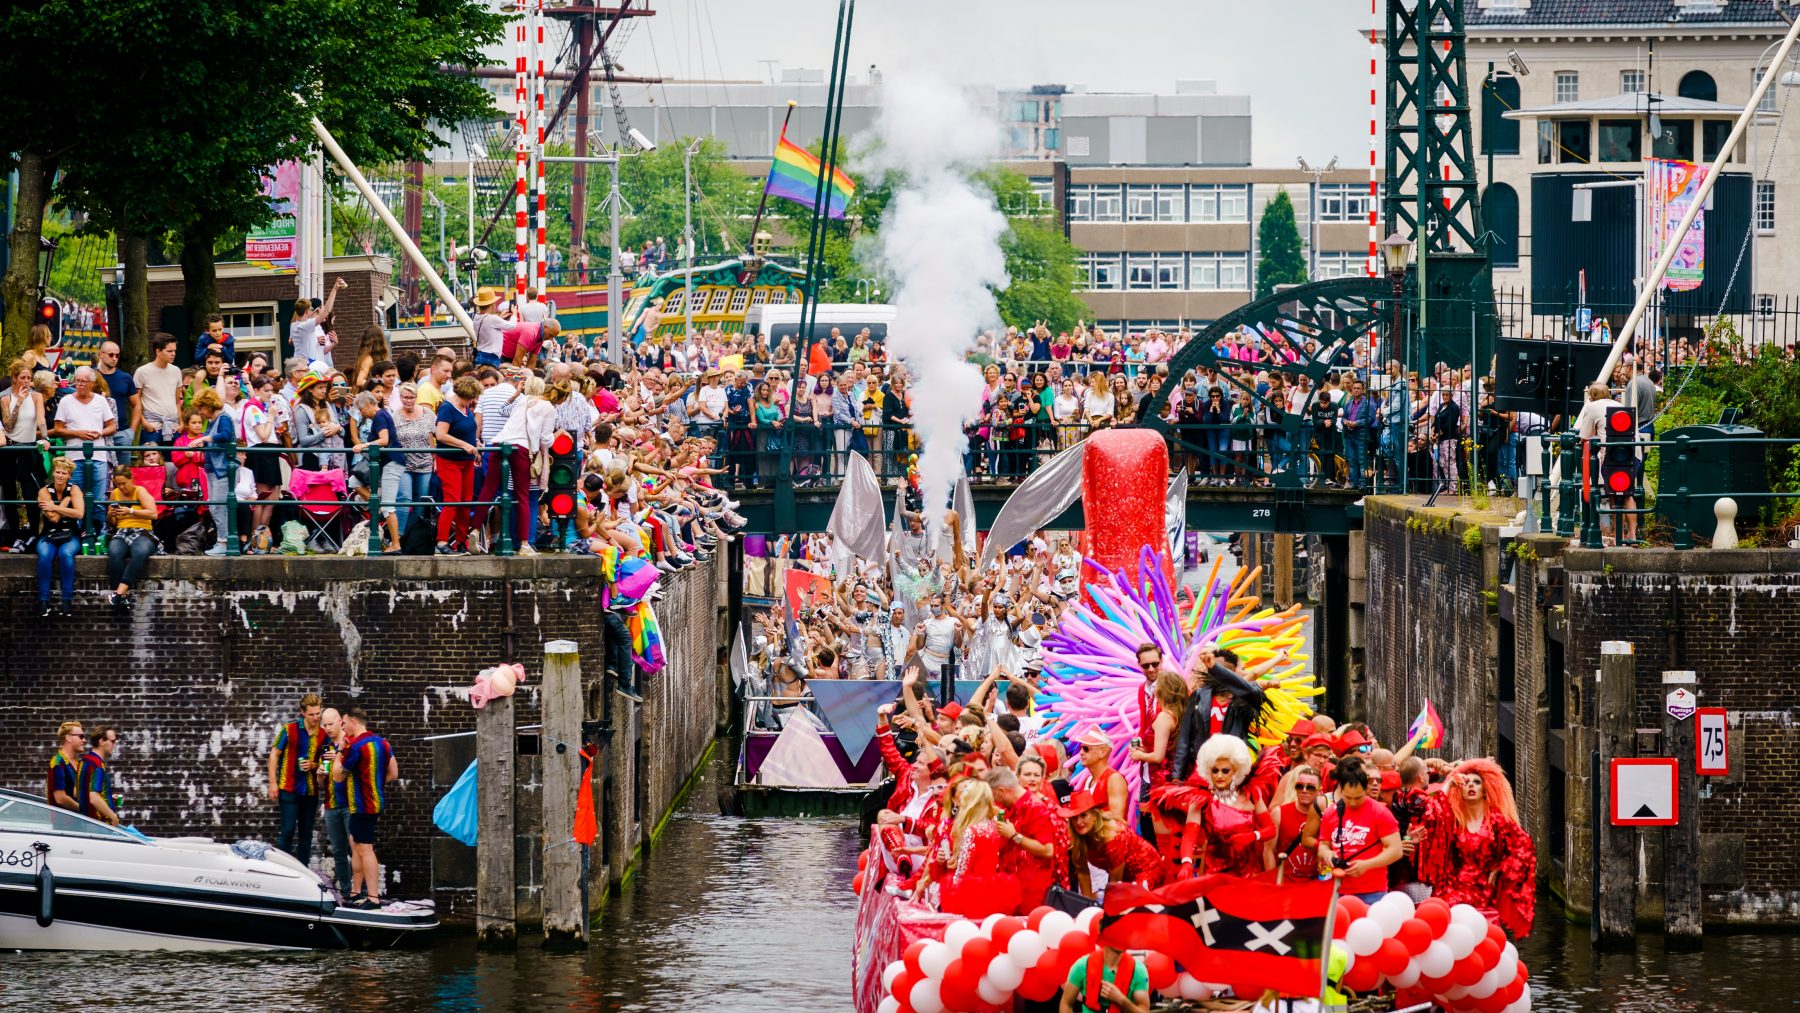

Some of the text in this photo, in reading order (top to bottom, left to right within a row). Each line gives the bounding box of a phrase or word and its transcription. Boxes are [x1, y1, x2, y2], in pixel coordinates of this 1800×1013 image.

[1670, 219, 1702, 231] TNS
[1252, 509, 1271, 517] 278
[1703, 727, 1724, 762] 7,5
